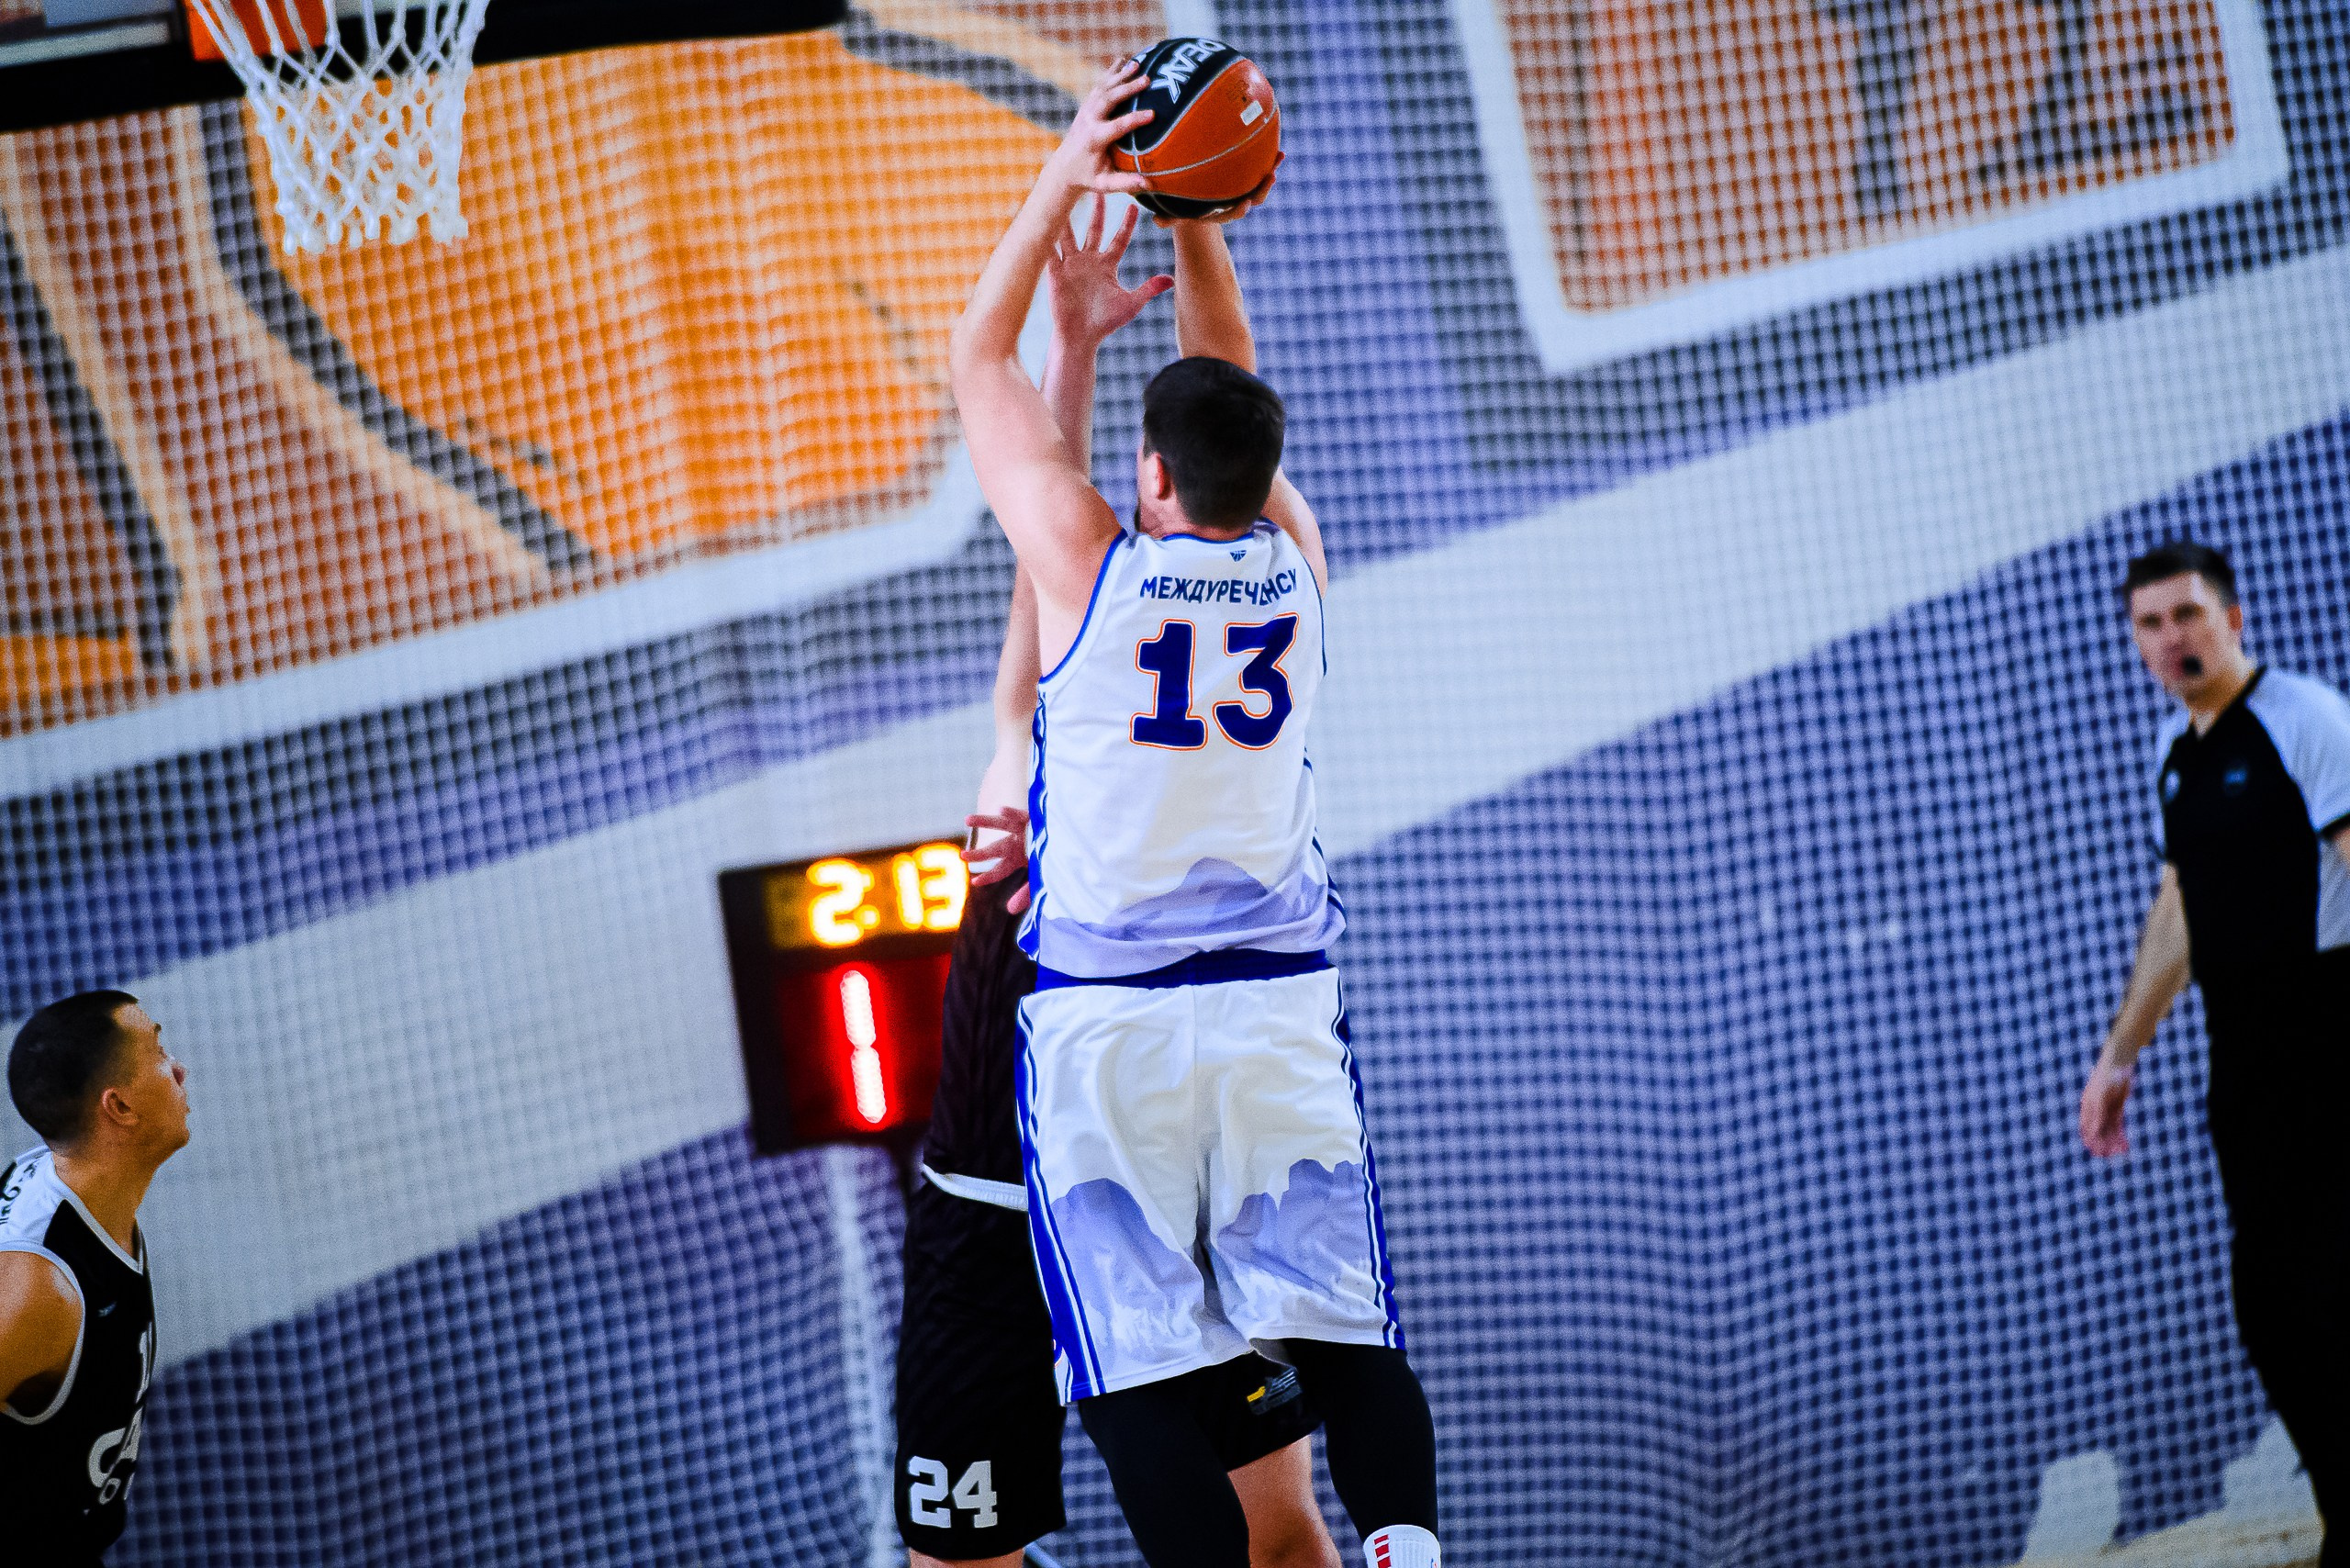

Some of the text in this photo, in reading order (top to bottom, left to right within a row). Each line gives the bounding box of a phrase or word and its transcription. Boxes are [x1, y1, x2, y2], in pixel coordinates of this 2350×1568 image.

[1129, 611, 1300, 751] 13
[834, 967, 891, 1127] 1
[909, 1456, 998, 1529] 24
